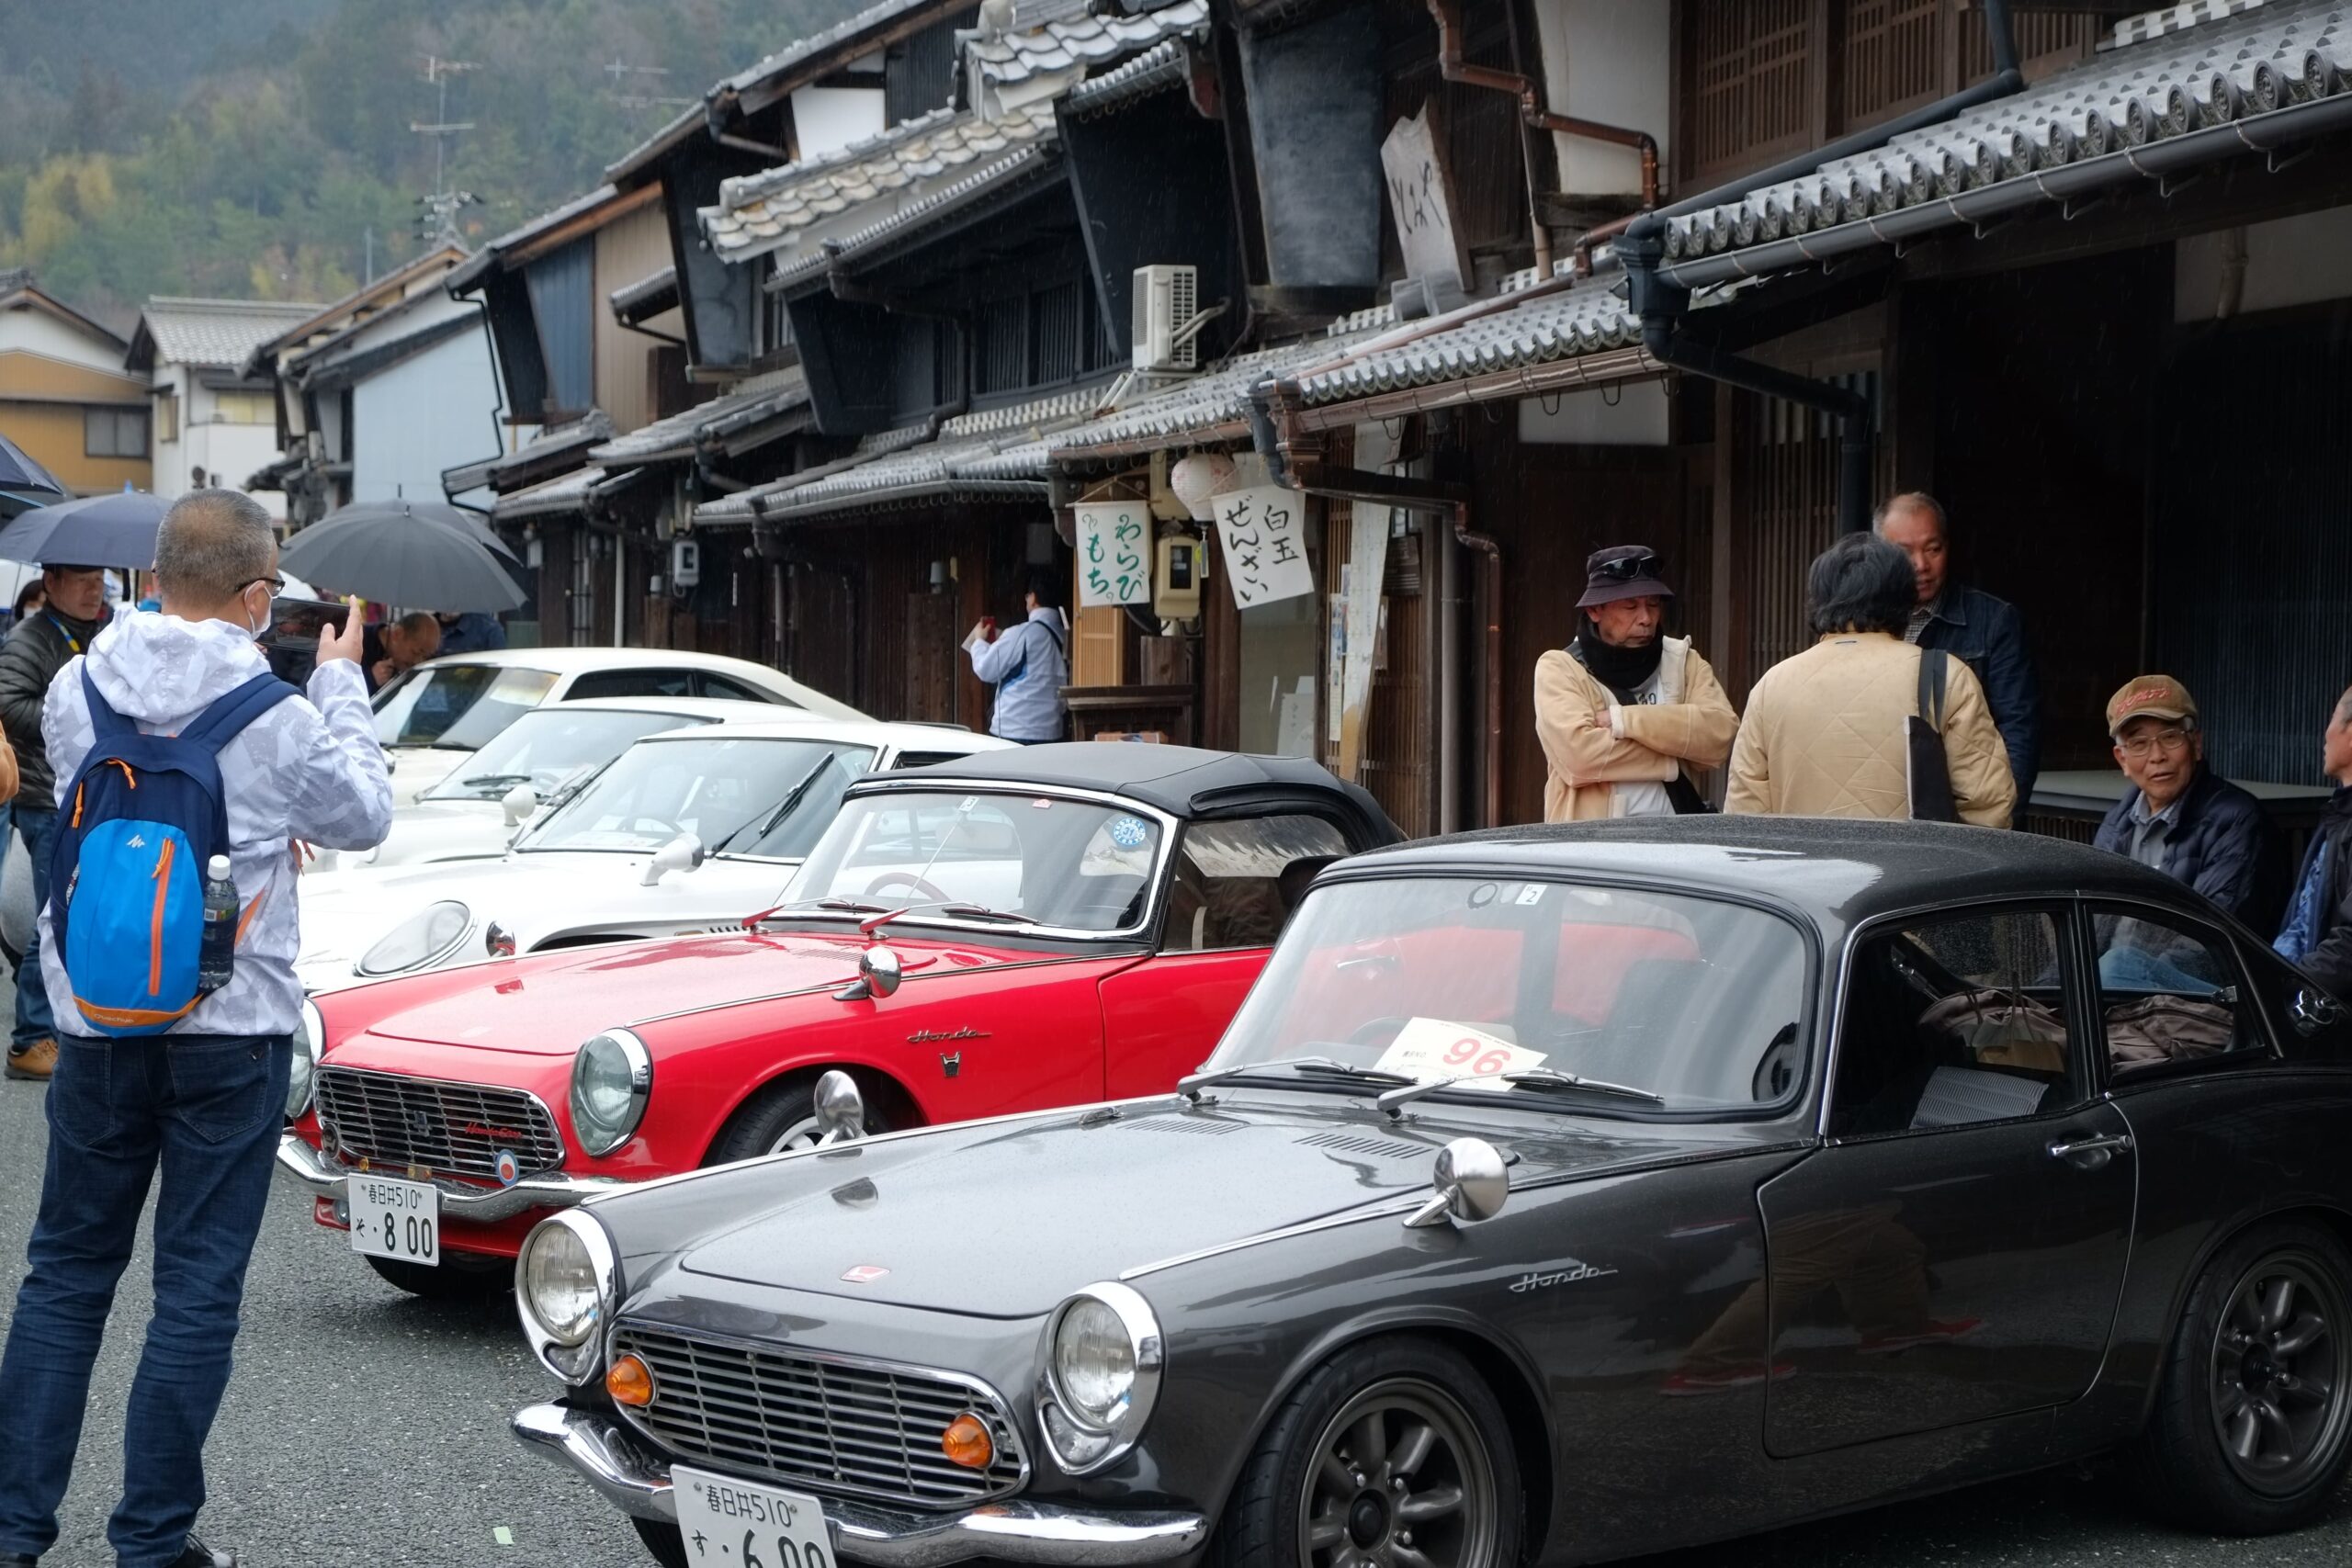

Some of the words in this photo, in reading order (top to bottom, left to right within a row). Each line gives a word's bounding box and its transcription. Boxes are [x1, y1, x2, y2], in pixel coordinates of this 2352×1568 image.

[1114, 513, 1145, 602] わらび
[1225, 494, 1268, 602] ぜんざい
[1263, 504, 1300, 565] 白玉
[1087, 533, 1110, 595] もち
[907, 1026, 992, 1043] Honda
[1442, 1037, 1511, 1076] 96
[1509, 1263, 1619, 1292] Honda
[691, 1529, 708, 1557] す
